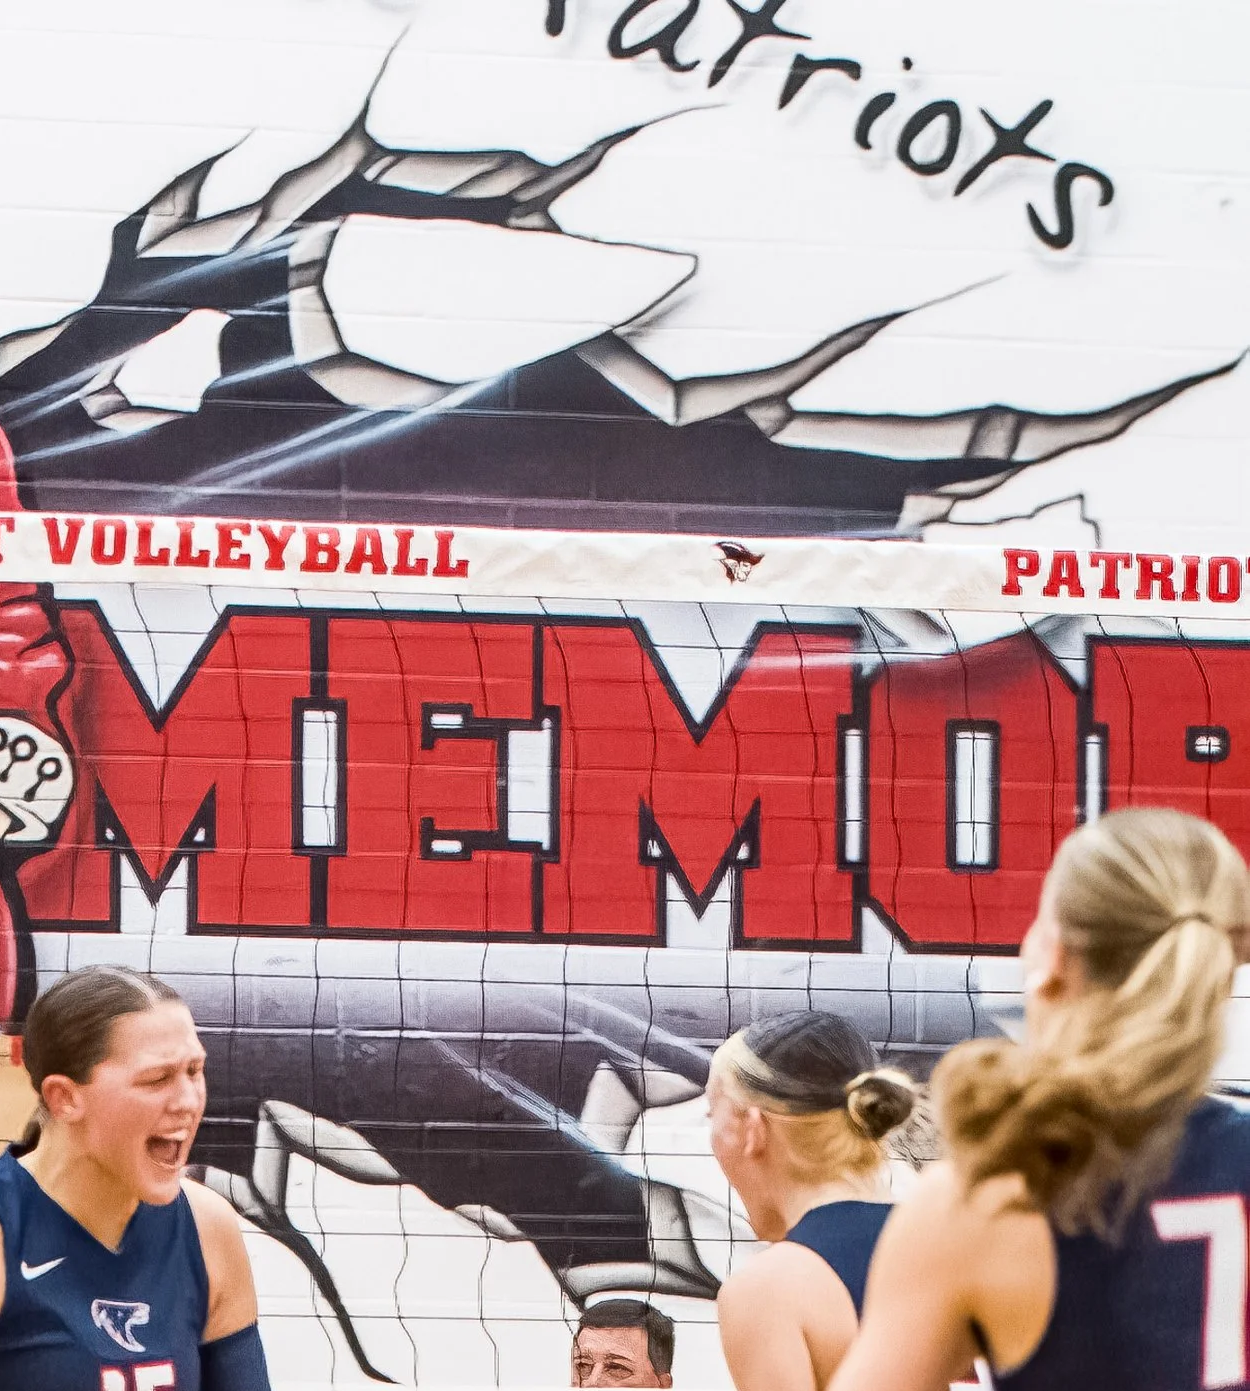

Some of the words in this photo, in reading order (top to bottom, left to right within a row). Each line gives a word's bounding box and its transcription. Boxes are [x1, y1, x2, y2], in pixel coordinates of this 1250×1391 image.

[546, 0, 1114, 249] atriots
[42, 517, 470, 578] VOLLEYBALL
[1001, 548, 1250, 604] PATRIO
